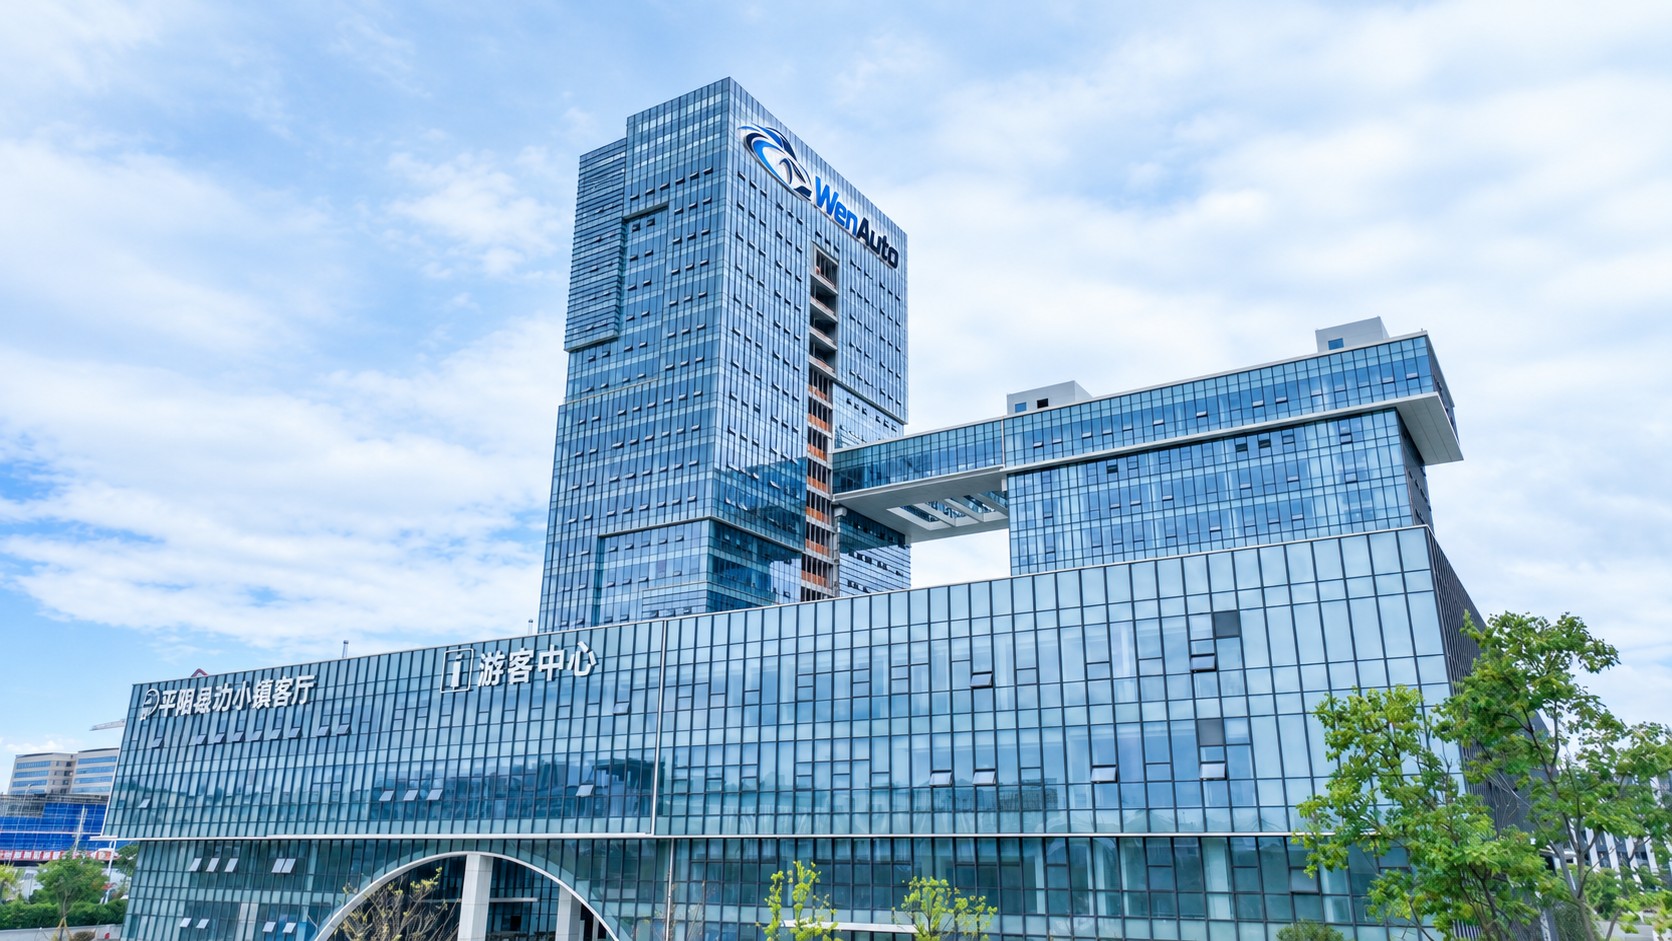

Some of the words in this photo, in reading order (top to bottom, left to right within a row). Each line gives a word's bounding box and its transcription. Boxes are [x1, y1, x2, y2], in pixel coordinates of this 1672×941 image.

[815, 176, 899, 269] WenAuto
[477, 641, 598, 688] 游客中心
